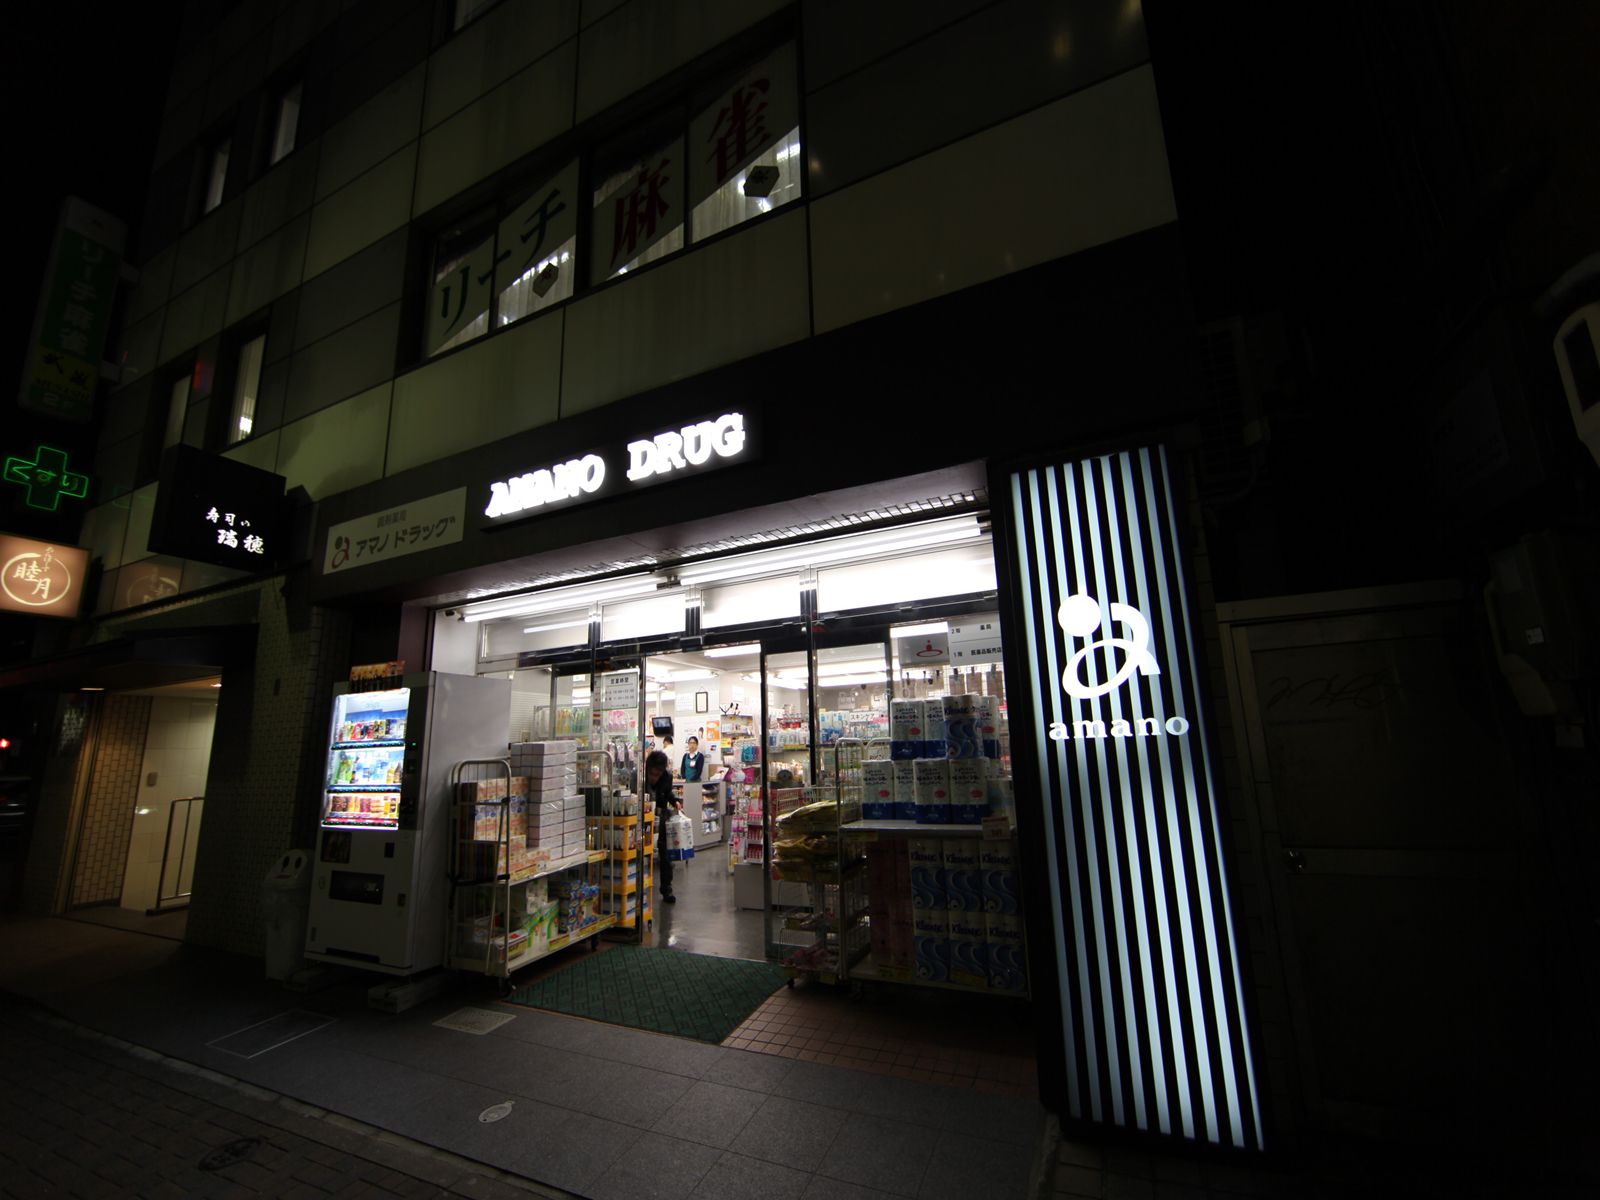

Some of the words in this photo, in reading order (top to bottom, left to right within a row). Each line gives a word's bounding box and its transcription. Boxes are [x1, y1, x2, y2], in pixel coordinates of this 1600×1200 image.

[484, 454, 606, 518] AMANO
[626, 412, 746, 481] DRUG
[217, 529, 265, 555] 瑞穂
[13, 560, 51, 599] 睦月
[1049, 716, 1190, 741] amano
